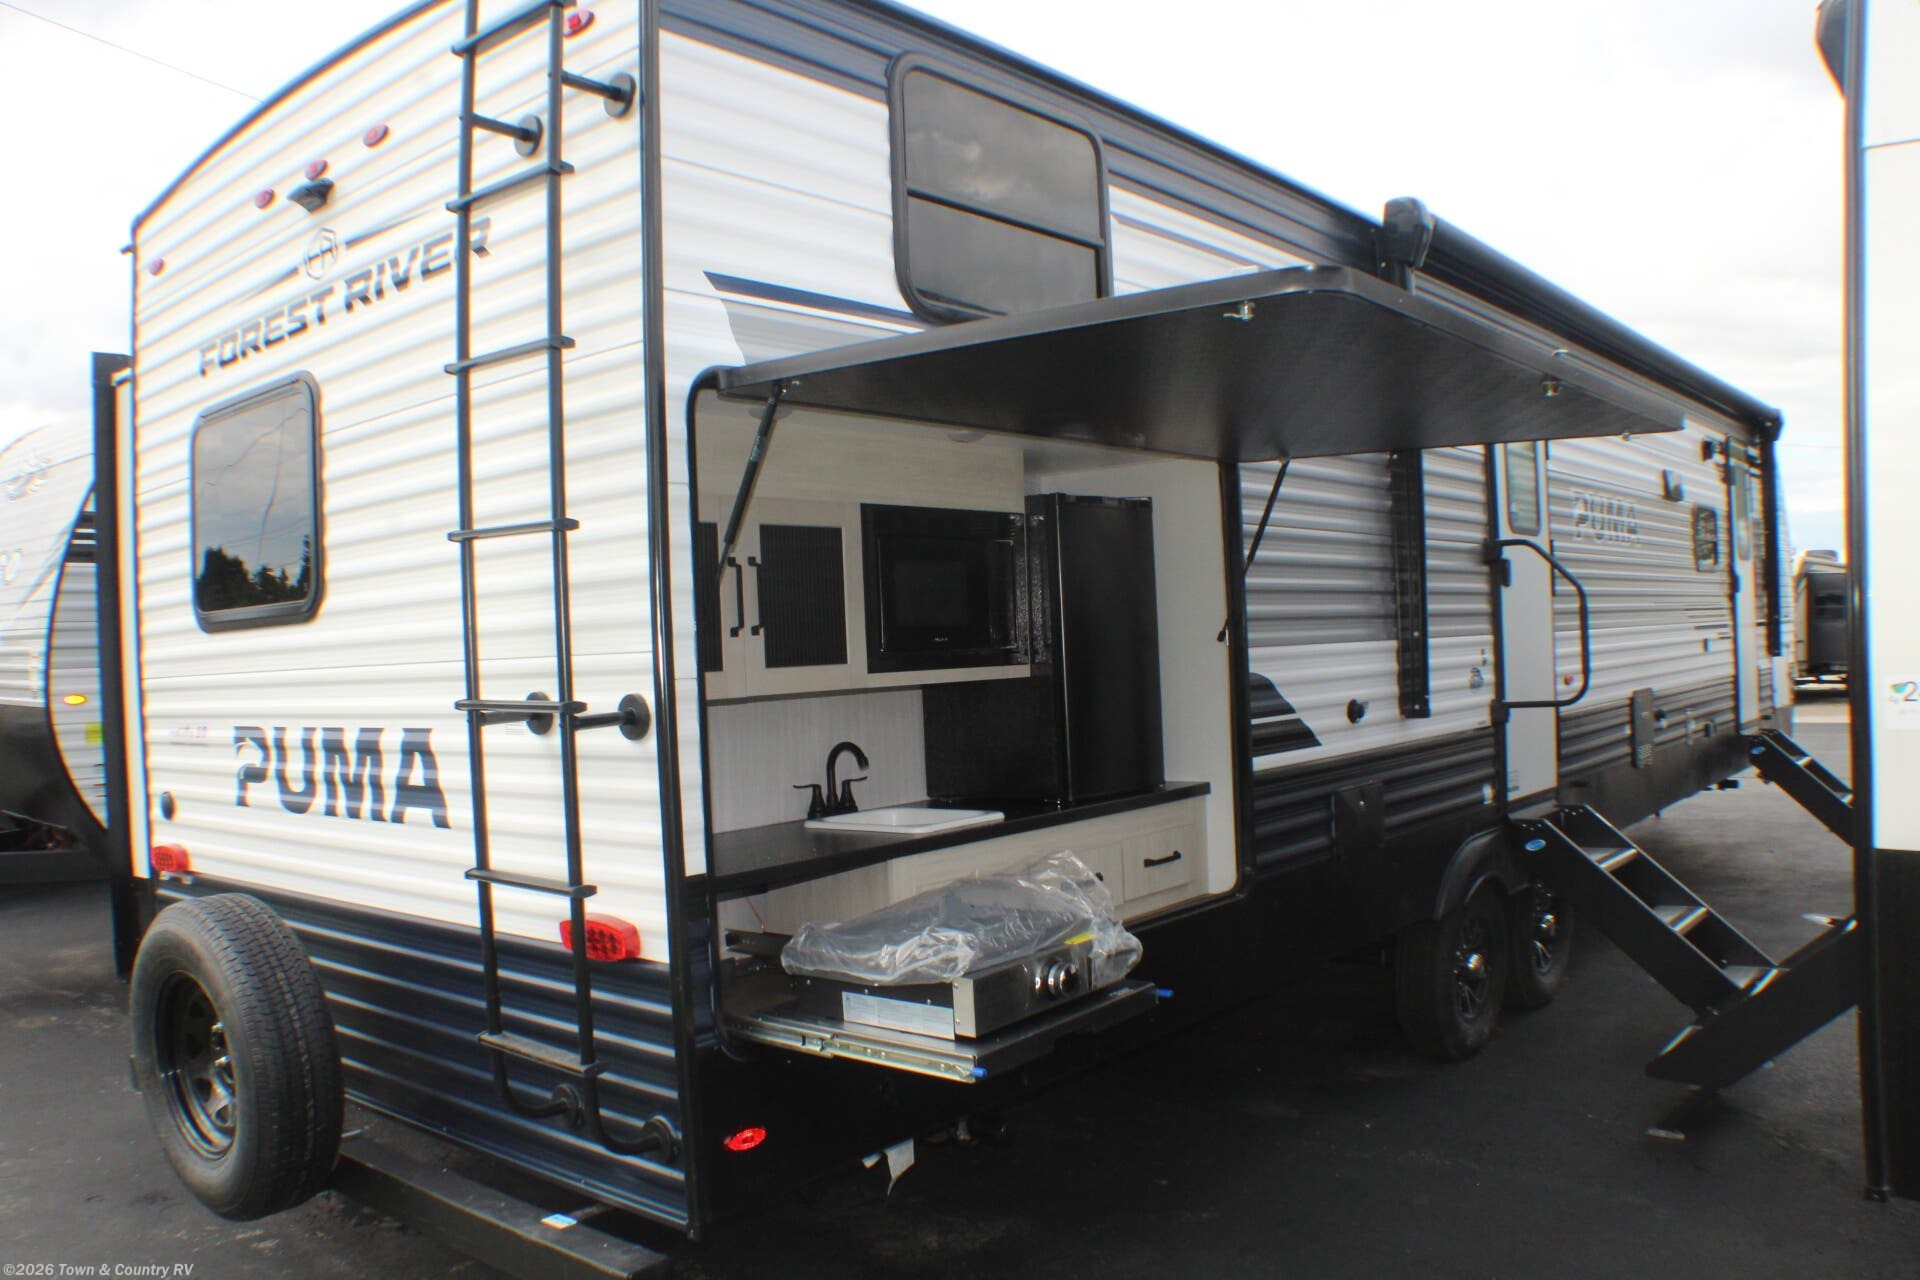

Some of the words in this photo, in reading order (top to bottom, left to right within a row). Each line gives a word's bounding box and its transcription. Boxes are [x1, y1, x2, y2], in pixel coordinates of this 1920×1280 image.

[199, 286, 335, 376] FOREST
[1573, 494, 1642, 544] PUMA
[233, 726, 452, 829] PUMA
